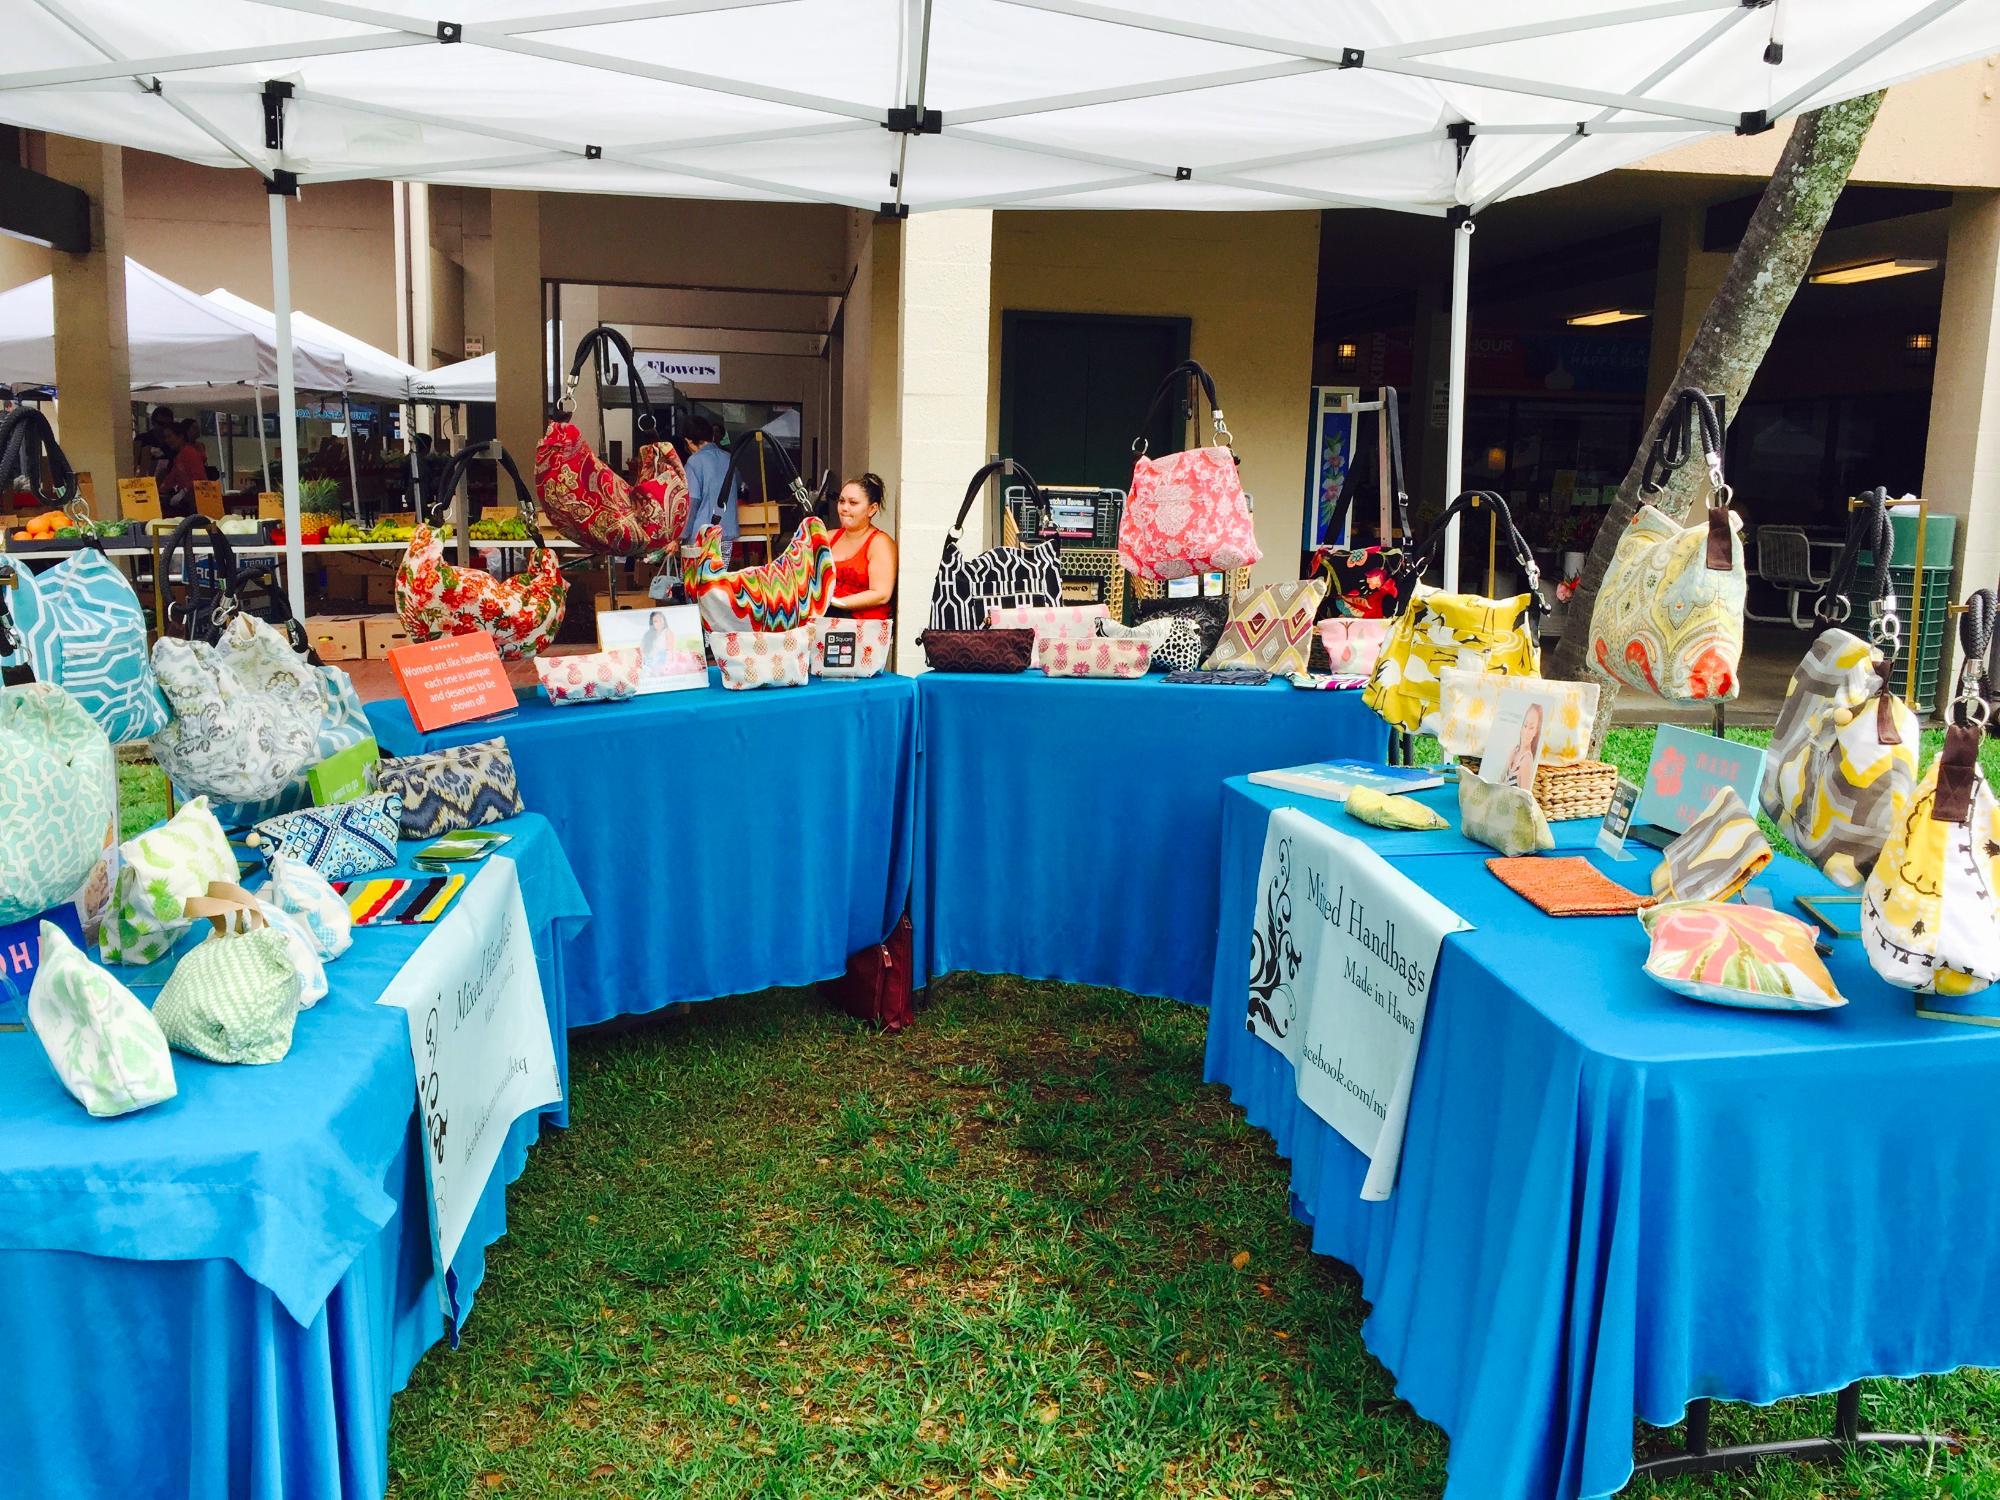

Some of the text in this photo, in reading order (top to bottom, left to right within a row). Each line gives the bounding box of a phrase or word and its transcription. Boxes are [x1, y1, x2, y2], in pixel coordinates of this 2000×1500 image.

[647, 360, 716, 376] Flowers
[402, 665, 434, 678] Women
[434, 661, 447, 671] are
[446, 657, 461, 668] like
[424, 667, 491, 689] each one is unique
[429, 679, 497, 703] and deserves to be
[450, 694, 487, 712] shown off
[1347, 898, 1426, 997] Handbags
[1344, 956, 1418, 1035] Made in Hawa
